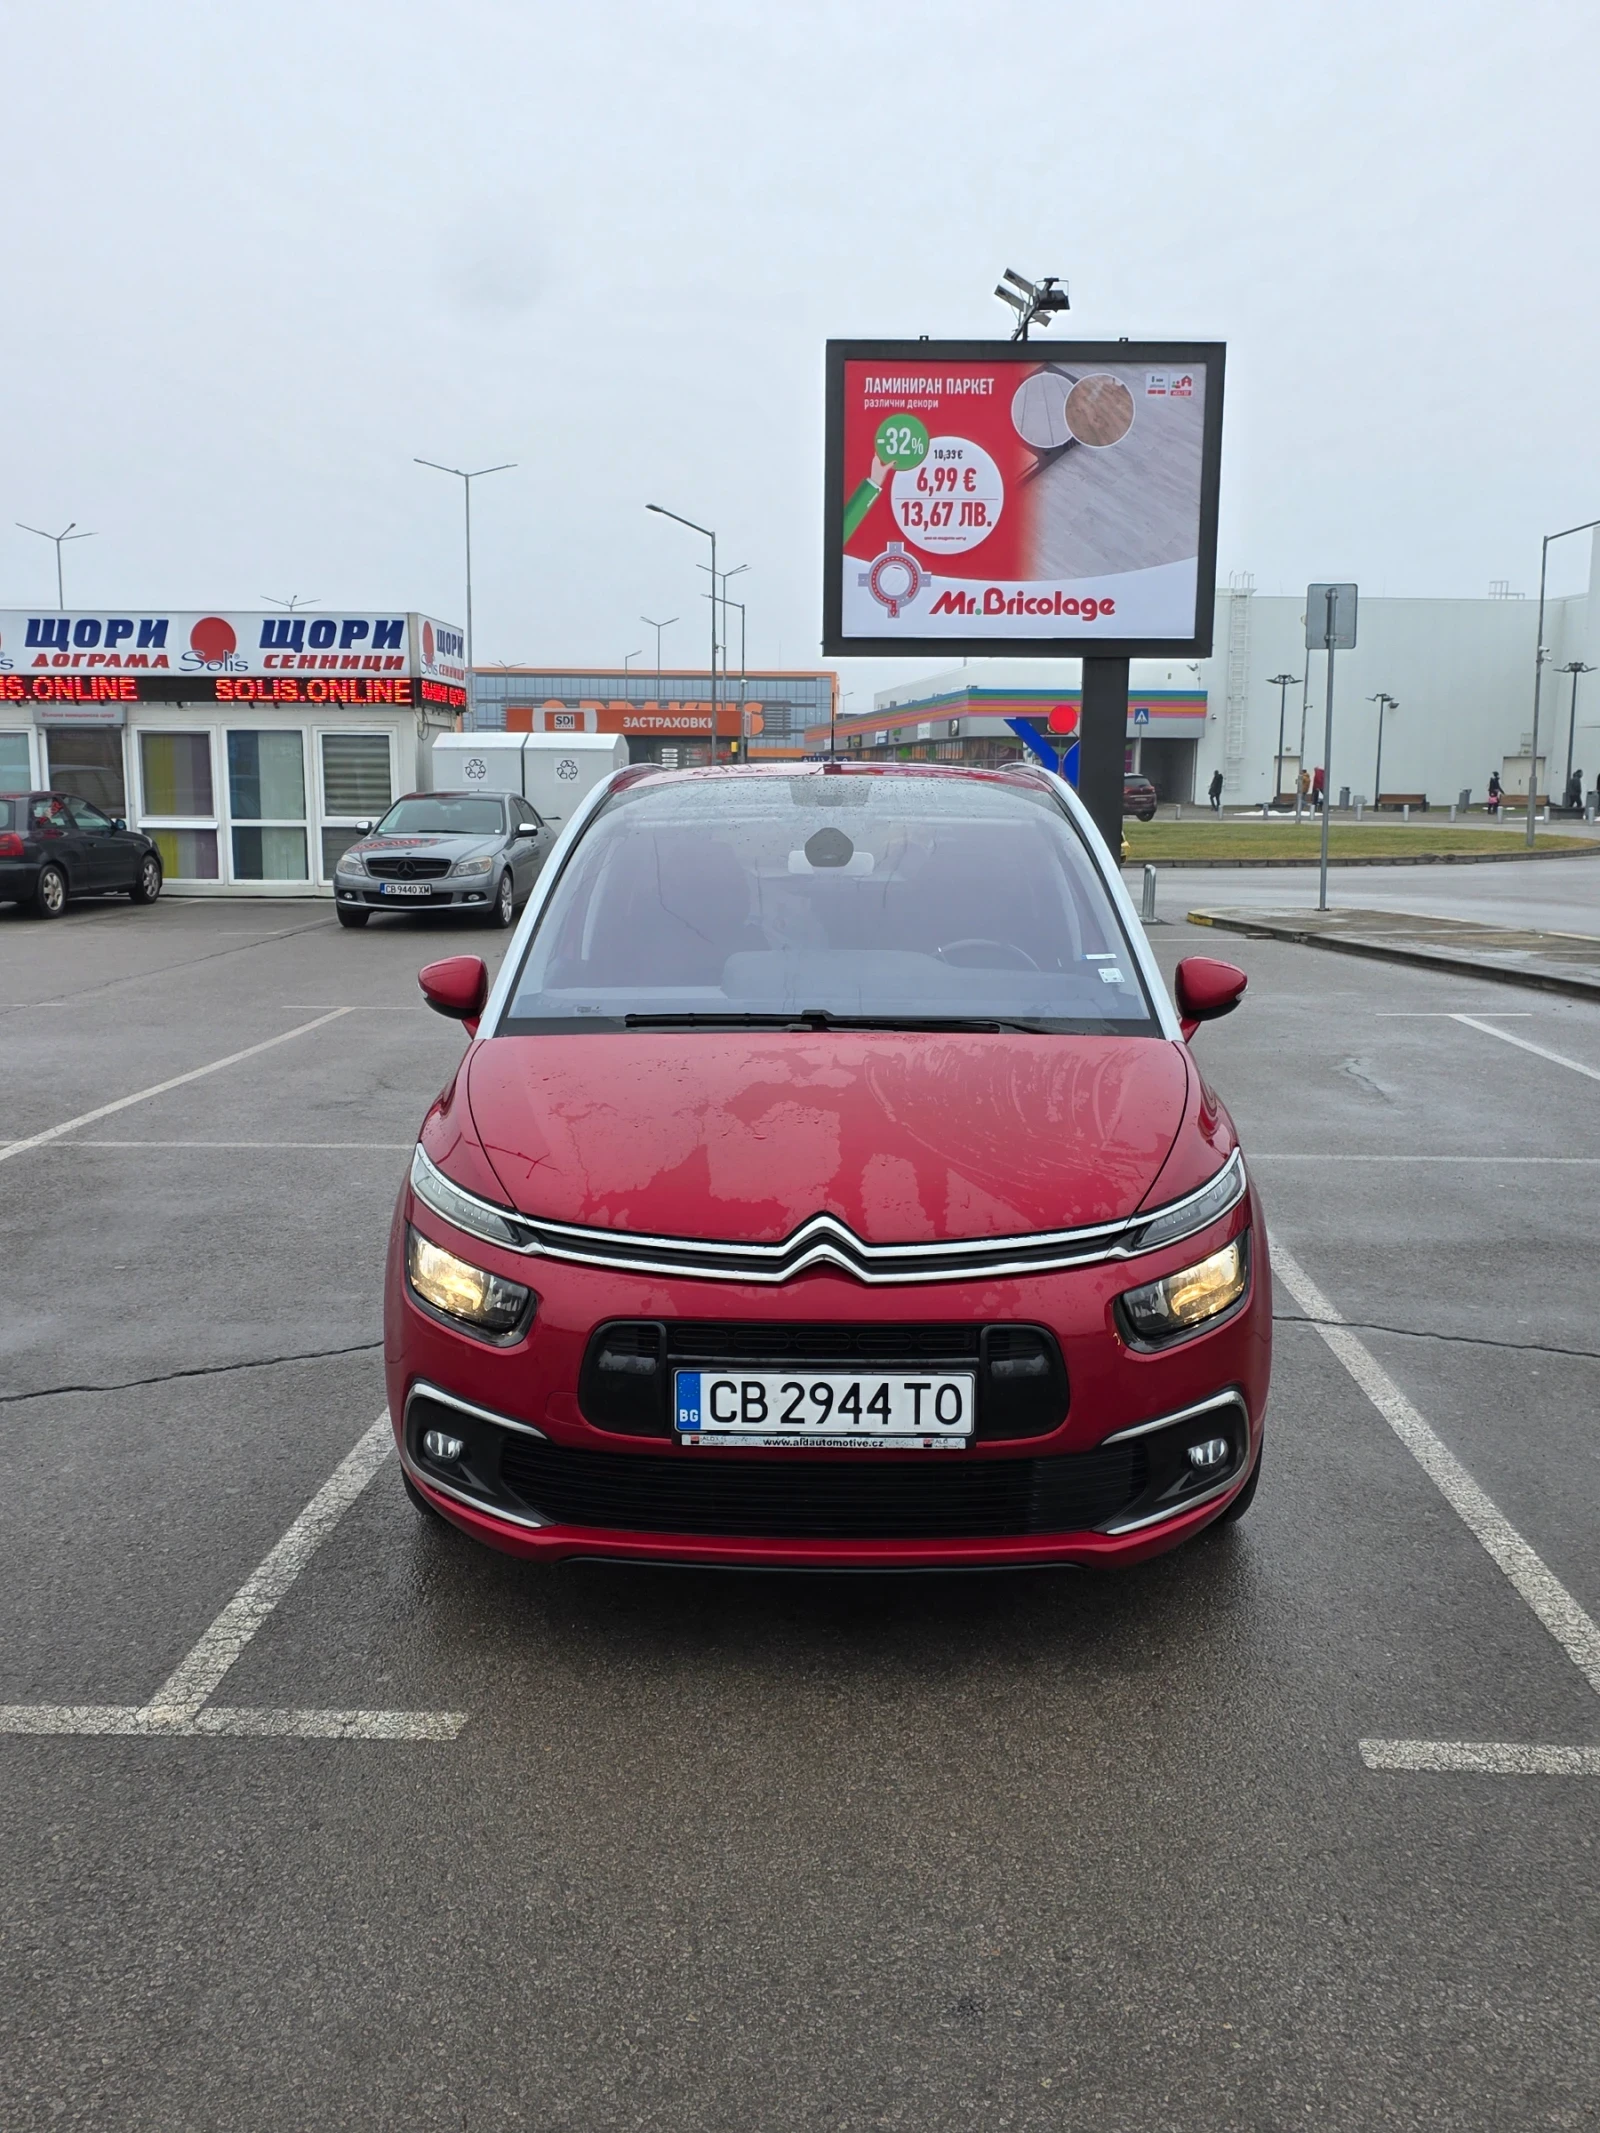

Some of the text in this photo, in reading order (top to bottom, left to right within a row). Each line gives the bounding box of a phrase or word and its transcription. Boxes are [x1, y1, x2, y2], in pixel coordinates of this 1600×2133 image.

[864, 377, 995, 395] ЛАМИНИРАН ПАРКЕТ
[864, 398, 939, 410] различни декори
[877, 427, 924, 455] -32%
[916, 467, 977, 497] 6,99 €
[901, 501, 992, 532] 13,67 ЛВ.
[25, 618, 169, 652] ЩОРИ
[259, 619, 405, 653] ЩОРИ
[436, 628, 464, 659] ЩОРИ
[31, 653, 170, 669] ДОГРАМА
[263, 654, 404, 672] СЕННИЦИ
[215, 678, 413, 703] SOLIS.ONLINE
[555, 716, 574, 726] SDI
[679, 1408, 699, 1423] BG
[709, 1380, 963, 1426] CB 2944 TO
